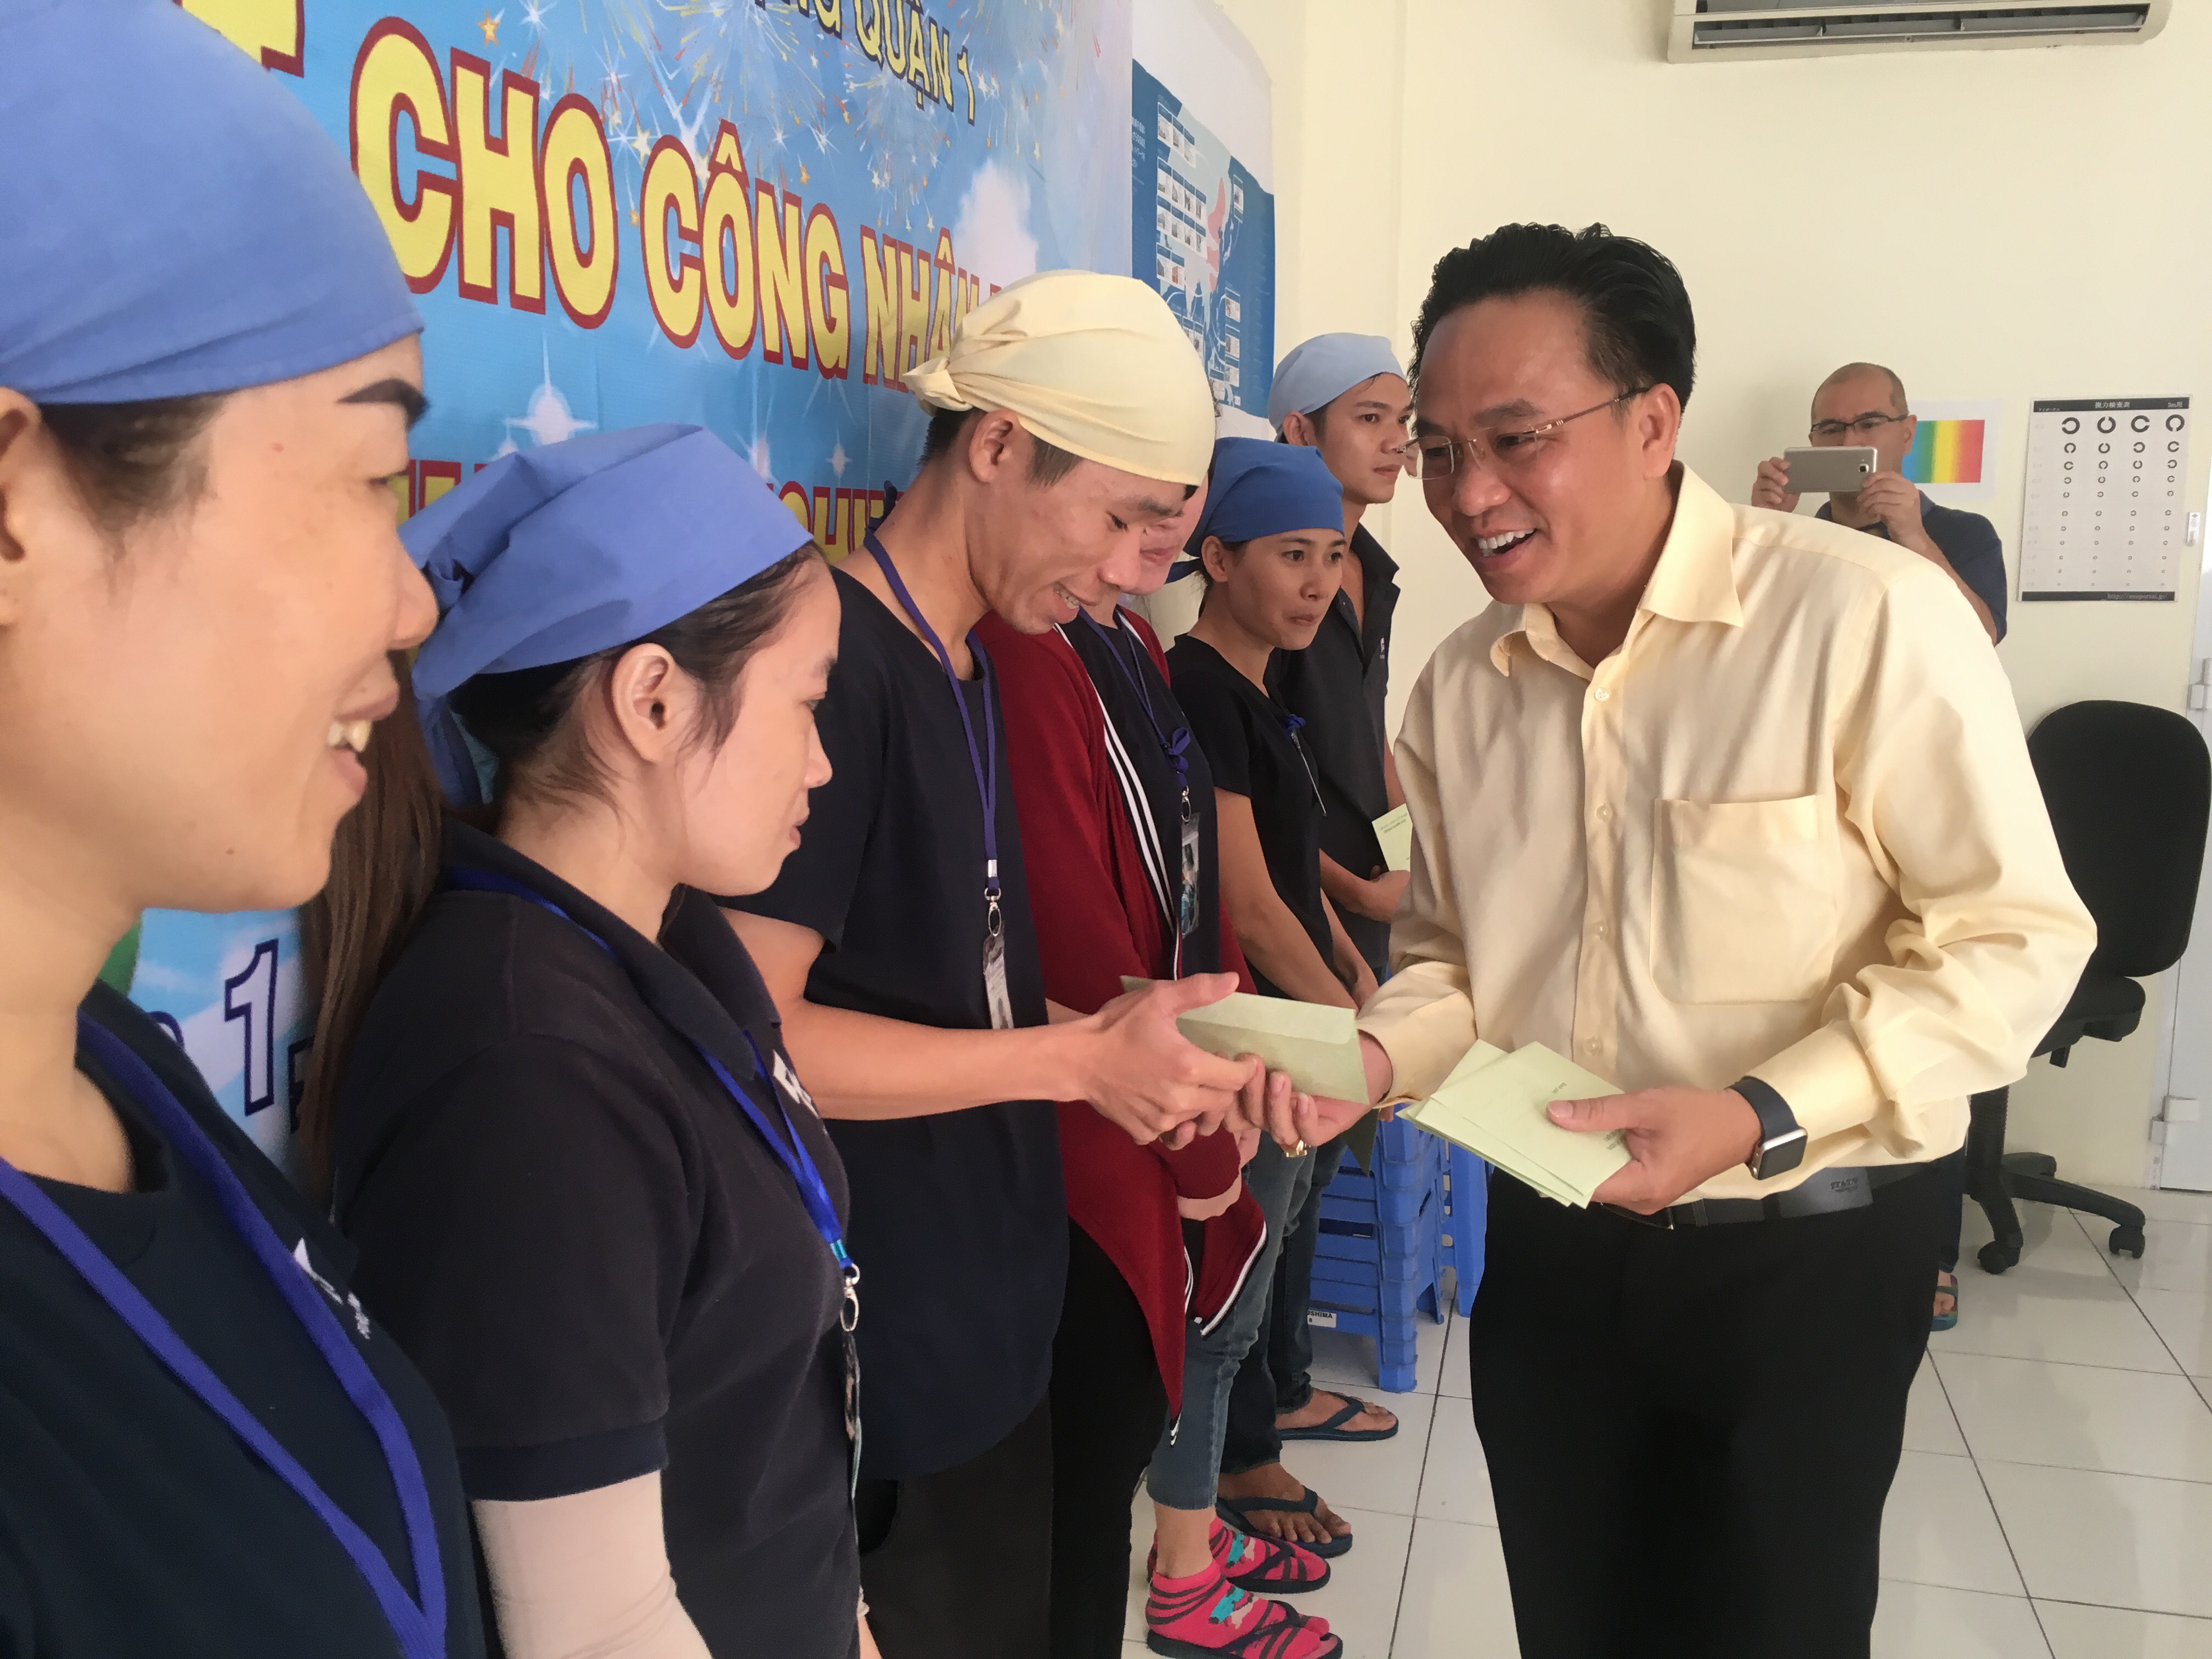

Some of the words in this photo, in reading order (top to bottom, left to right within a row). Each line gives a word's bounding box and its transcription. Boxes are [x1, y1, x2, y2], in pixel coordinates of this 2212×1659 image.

[957, 45, 975, 126] 1
[349, 16, 619, 329] CHO
[640, 118, 851, 380] CÔNG
